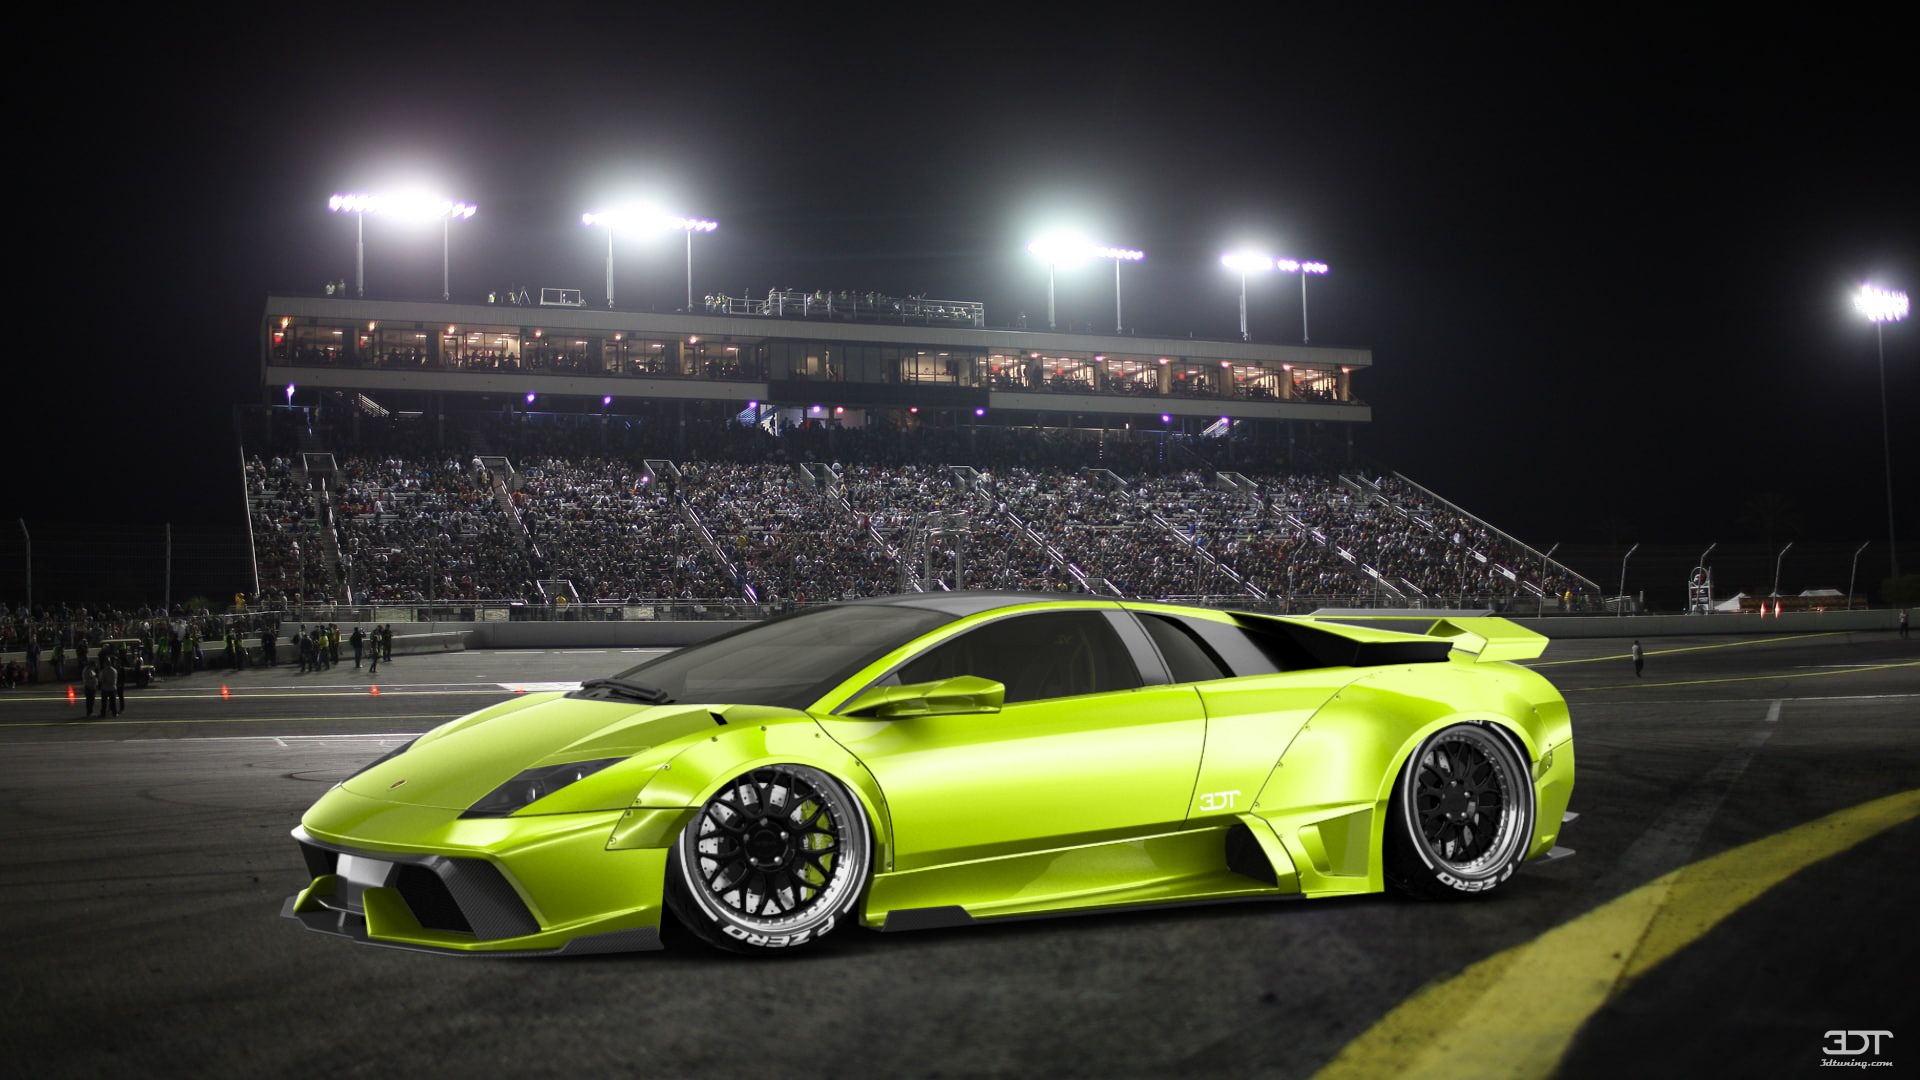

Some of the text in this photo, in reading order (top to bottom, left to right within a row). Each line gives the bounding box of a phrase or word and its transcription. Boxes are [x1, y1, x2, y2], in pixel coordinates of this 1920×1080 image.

[1200, 790, 1241, 811] 3DT
[1437, 872, 1498, 891] ZERO
[722, 915, 834, 947] P ZERO
